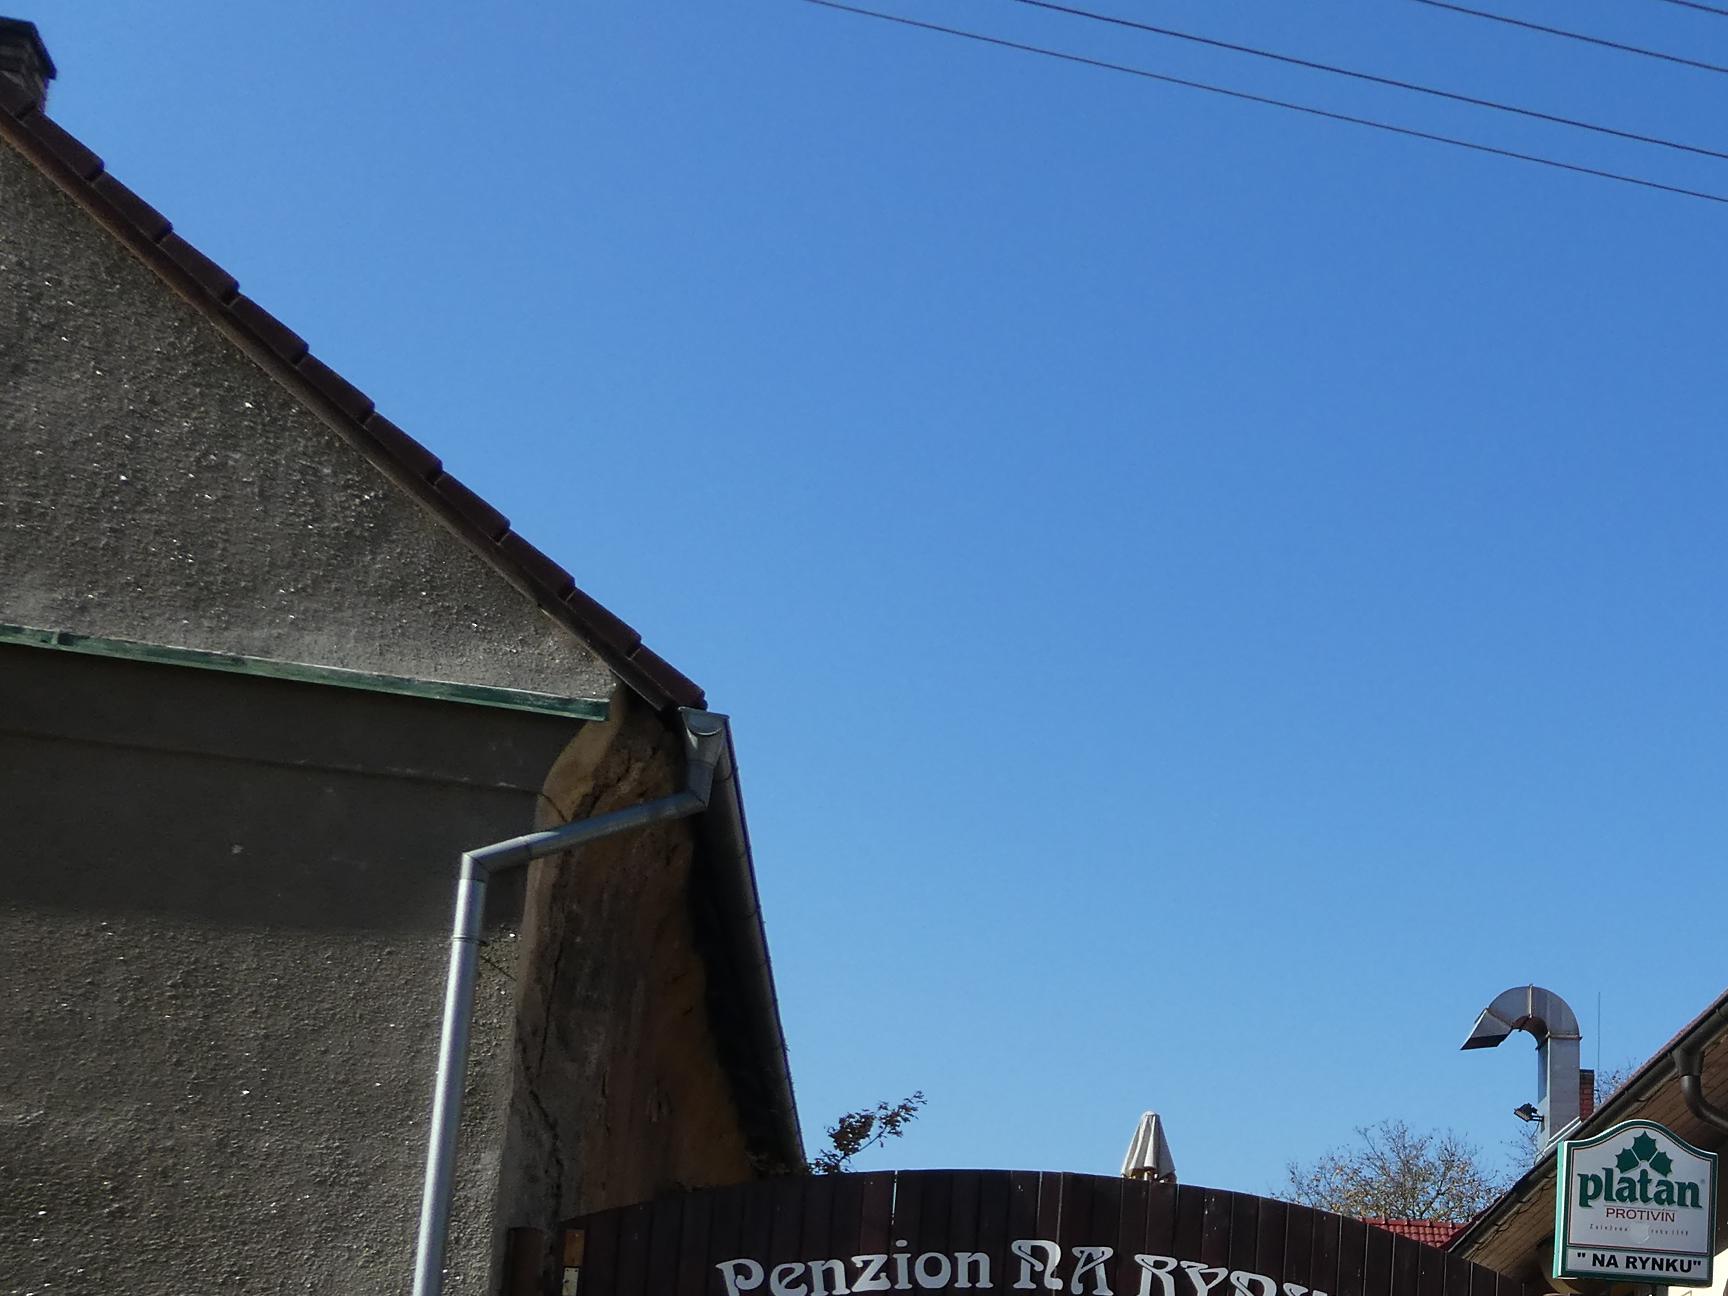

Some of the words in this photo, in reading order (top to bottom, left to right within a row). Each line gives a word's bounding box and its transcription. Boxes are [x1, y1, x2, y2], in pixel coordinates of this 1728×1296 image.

[1577, 1167, 1703, 1209] platan
[1605, 1207, 1676, 1223] PROTIVÍN
[1011, 1239, 1114, 1296] NA
